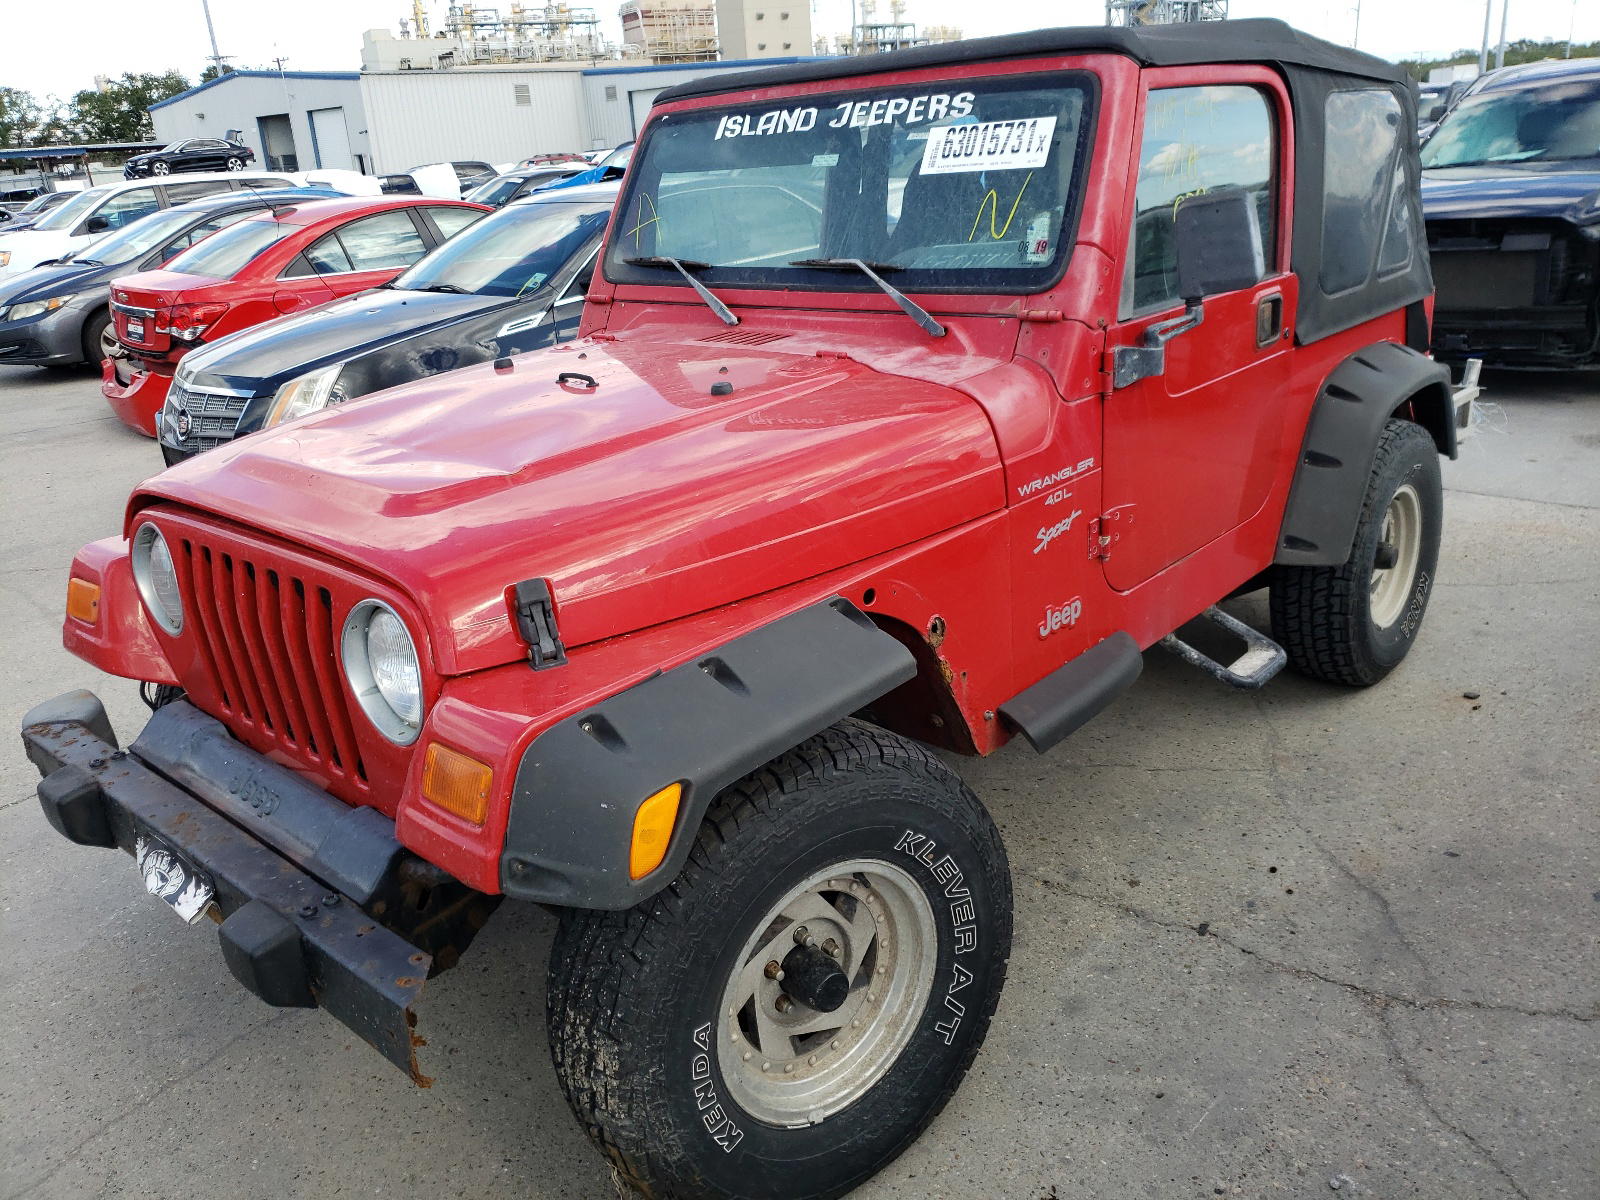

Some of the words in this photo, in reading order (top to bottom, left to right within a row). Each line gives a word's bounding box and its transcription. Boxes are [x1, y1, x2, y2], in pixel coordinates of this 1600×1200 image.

[715, 107, 818, 141] ISLAND
[829, 92, 976, 129] JEEPERS
[1035, 240, 1048, 254] 19
[1018, 457, 1094, 497] WRANGLER
[1040, 599, 1082, 637] Jeep
[894, 830, 978, 955] KLEVER
[934, 963, 974, 1046] A/T
[692, 1022, 744, 1153] KENDA
